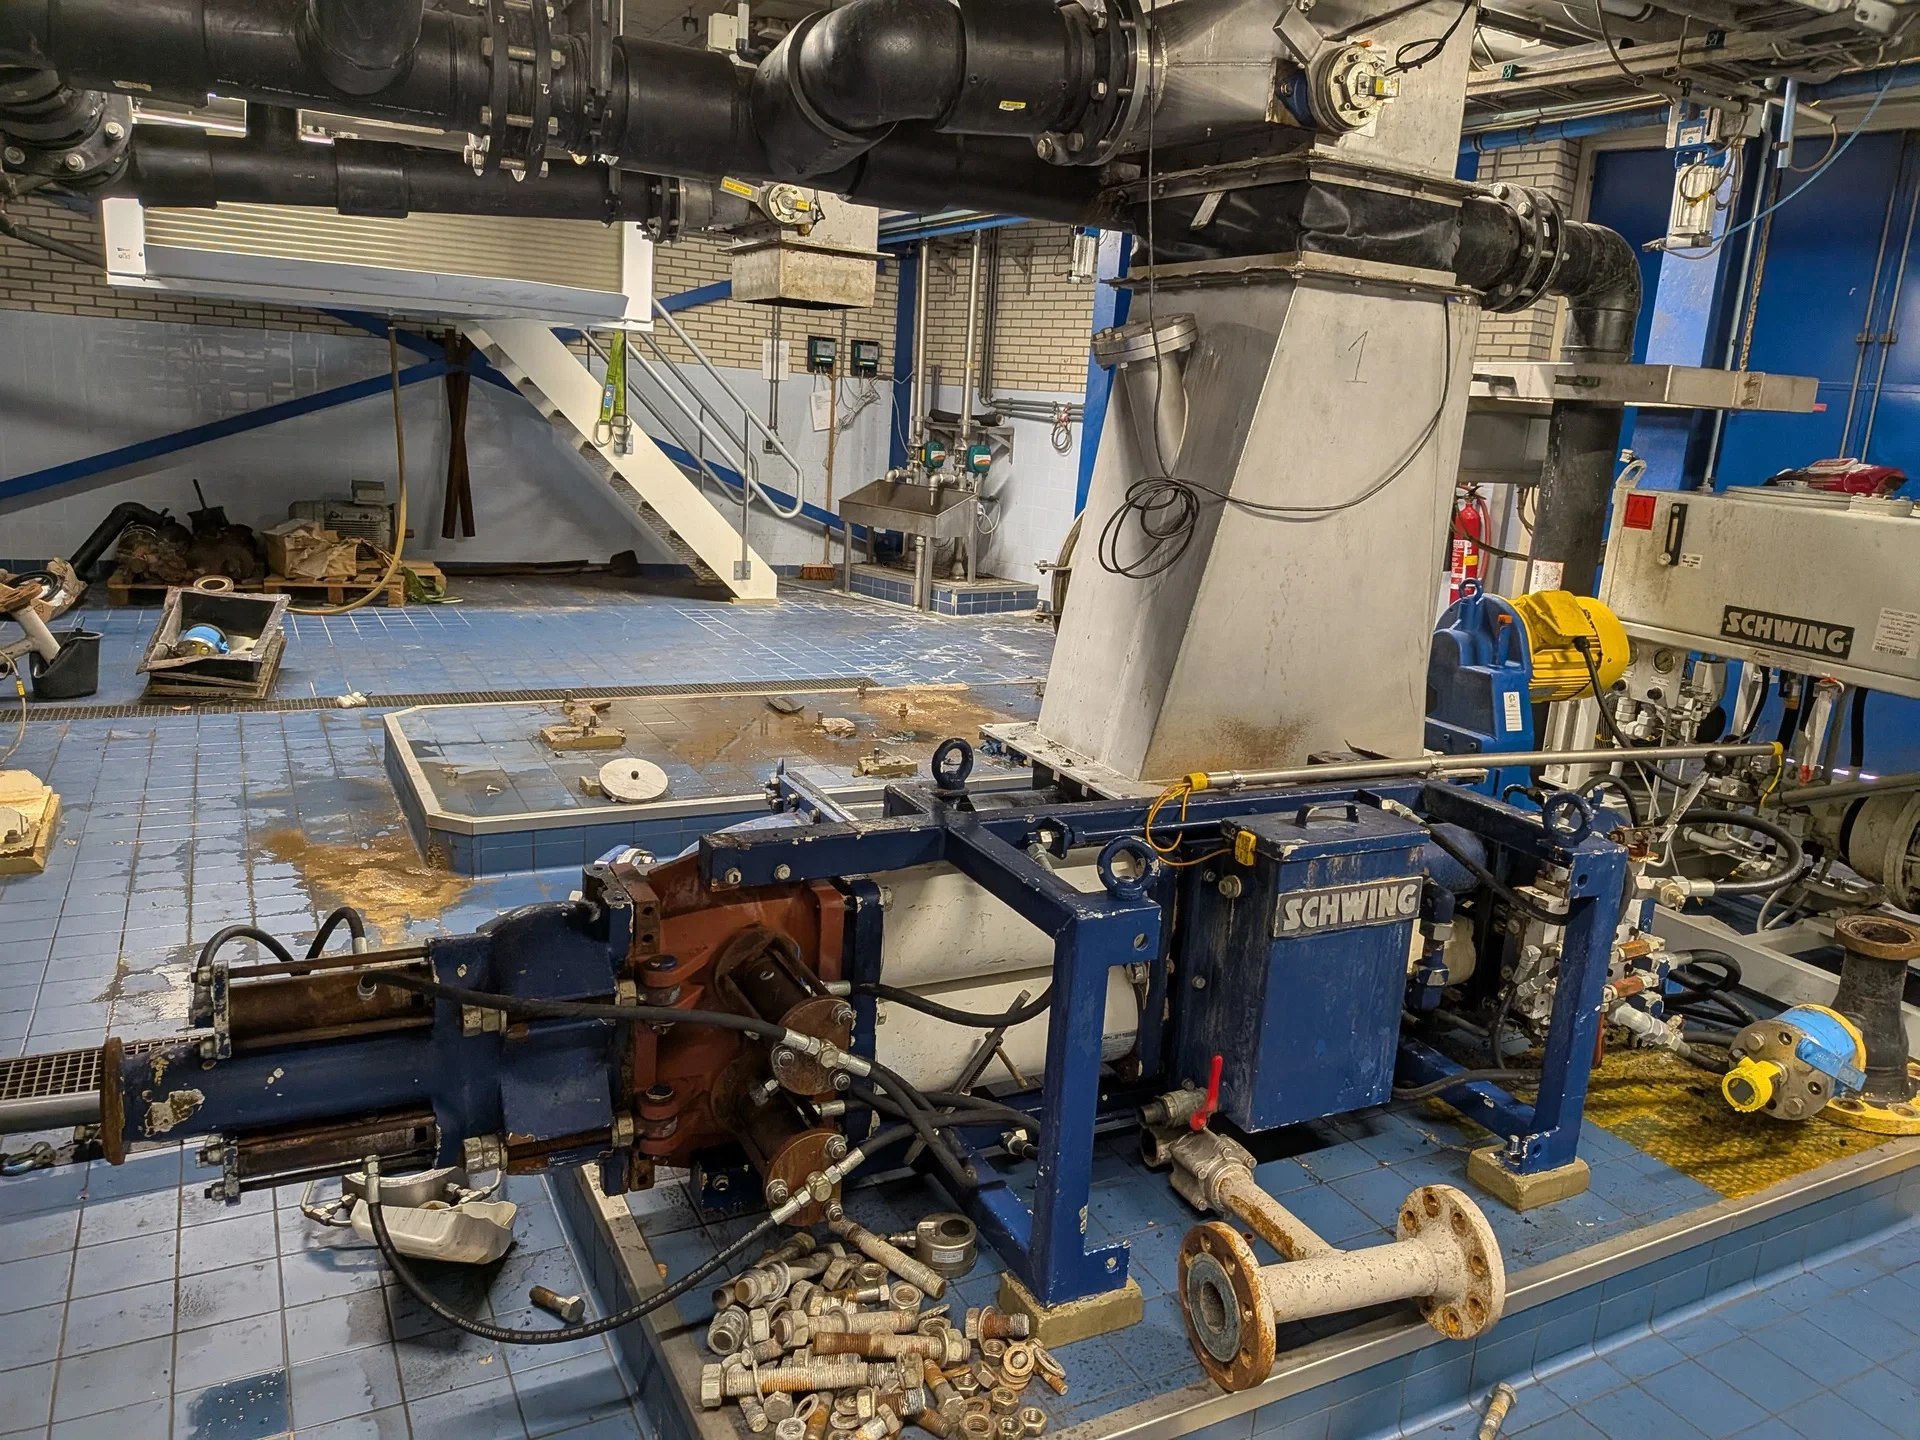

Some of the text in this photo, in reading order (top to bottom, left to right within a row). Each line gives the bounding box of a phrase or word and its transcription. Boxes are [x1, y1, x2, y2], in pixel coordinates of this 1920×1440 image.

[1345, 330, 1368, 384] 1
[1725, 611, 1847, 653] SCHWING
[1283, 884, 1417, 931] SCHWING
